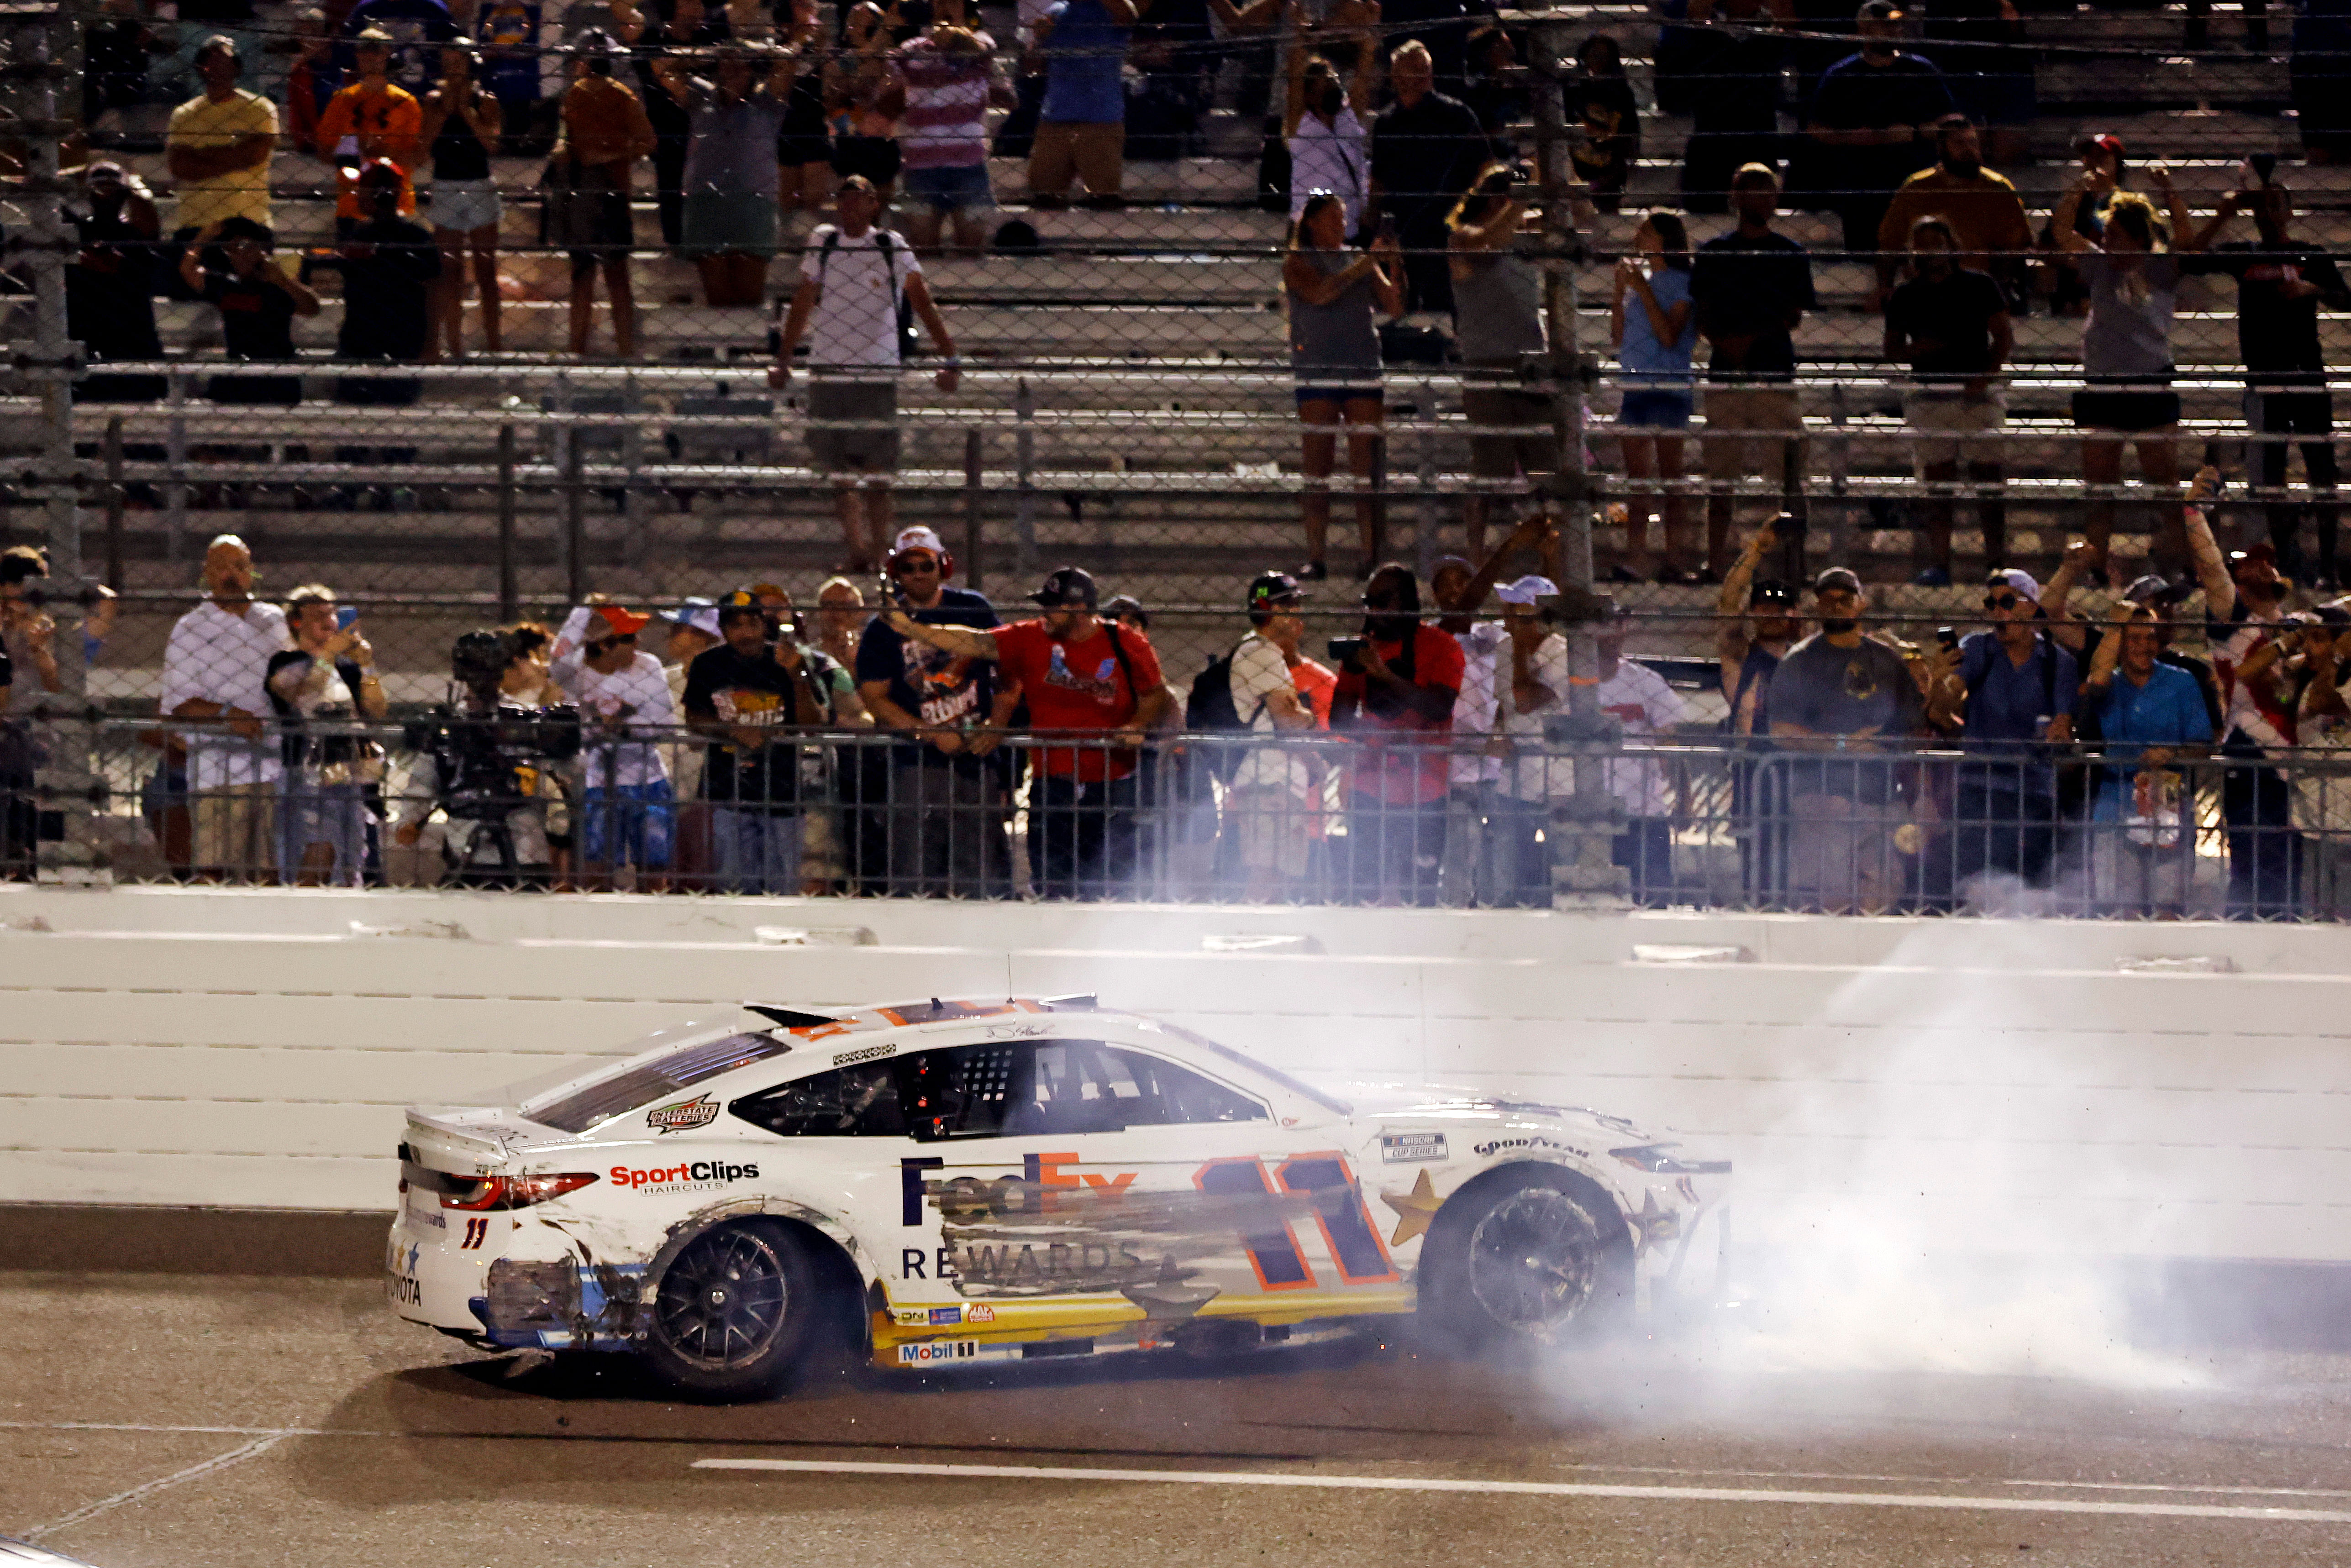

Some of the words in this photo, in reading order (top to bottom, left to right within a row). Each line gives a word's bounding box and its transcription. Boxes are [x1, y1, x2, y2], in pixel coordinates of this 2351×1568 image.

[652, 1107, 713, 1117] INTERSTATE
[655, 1114, 710, 1123] BATTERIES
[610, 1161, 760, 1189] SportClips
[644, 1182, 724, 1195] HAIRCUTS
[461, 1217, 489, 1250] 11
[388, 1272, 421, 1307] OYOTA
[903, 1343, 952, 1361] Mobil
